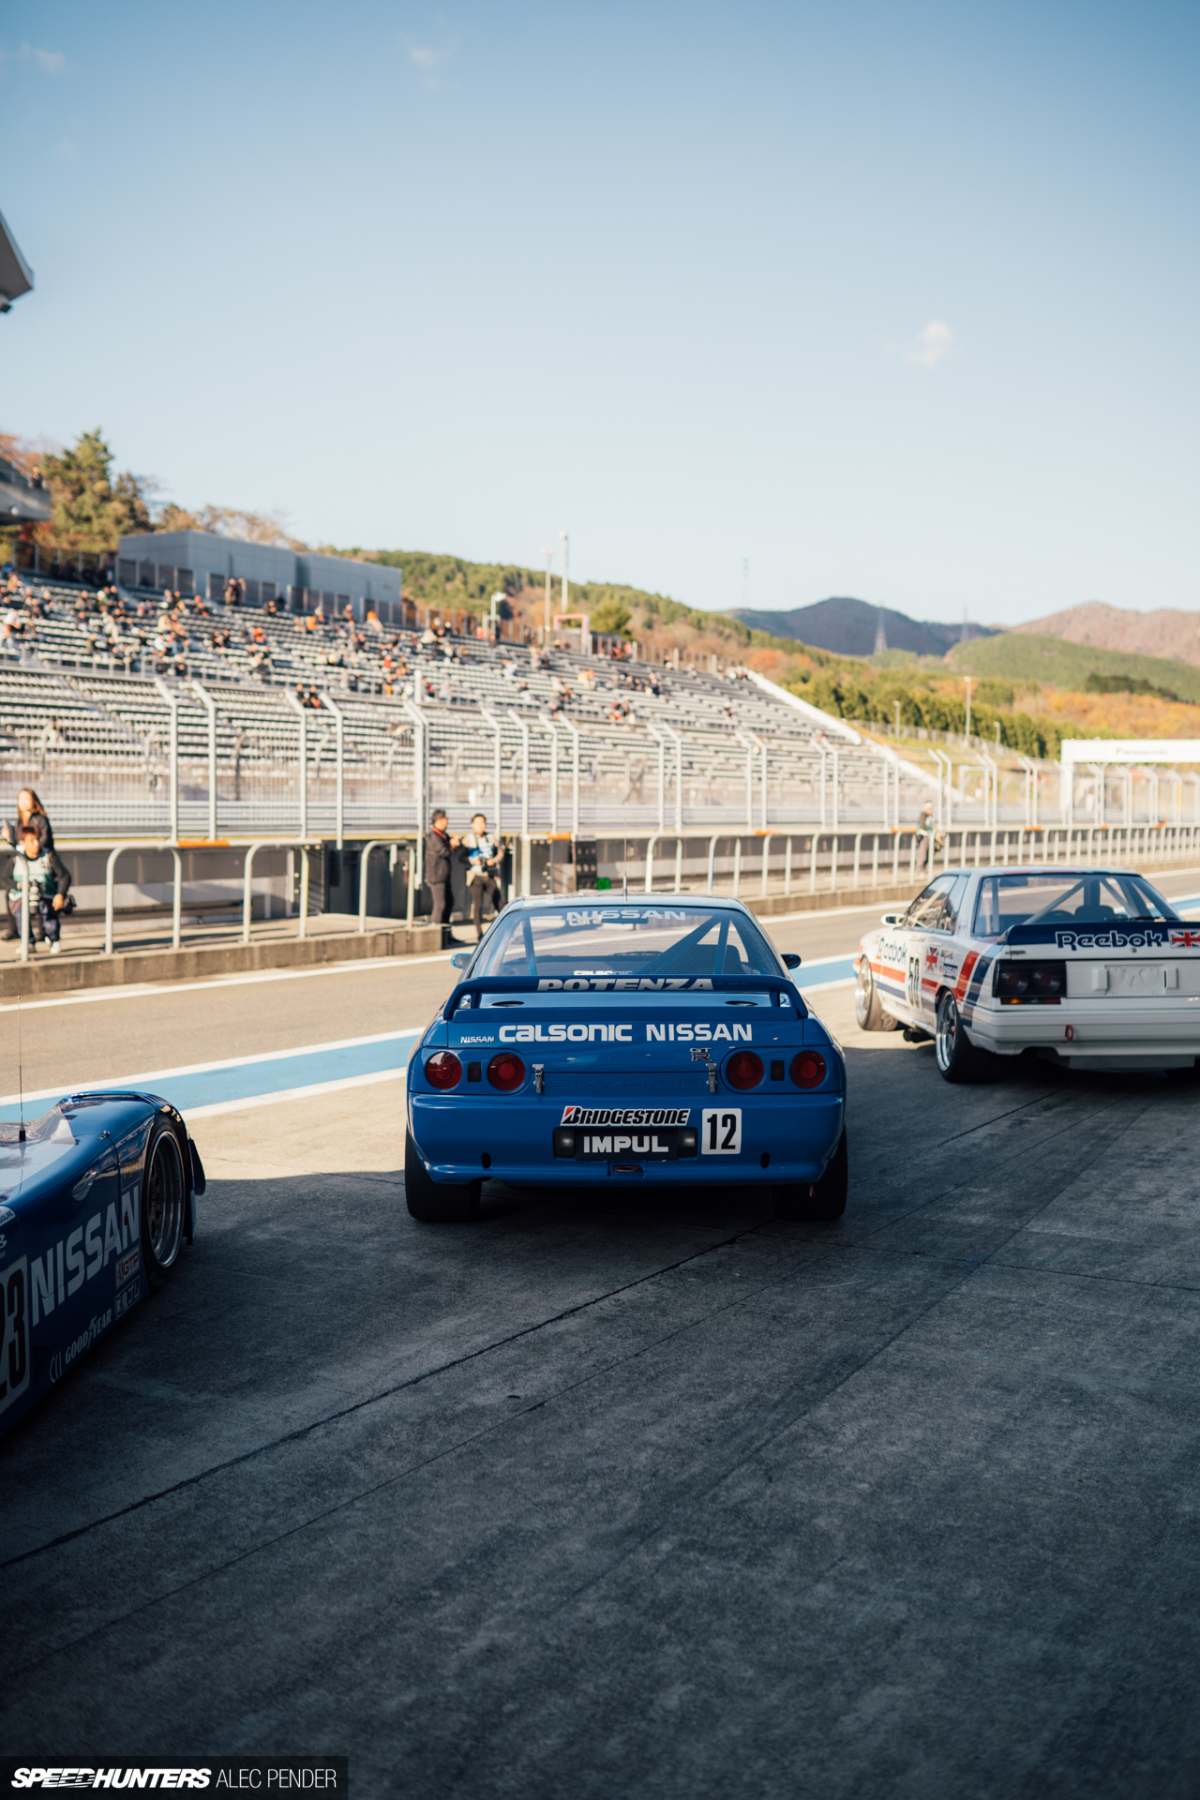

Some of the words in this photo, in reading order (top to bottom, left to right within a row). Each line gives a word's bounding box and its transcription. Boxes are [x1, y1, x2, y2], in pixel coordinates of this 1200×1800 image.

[566, 909, 686, 921] NISSAN
[878, 937, 908, 965] Reebok
[1055, 930, 1162, 951] Reebok
[537, 978, 714, 991] POTENZA
[908, 956, 920, 1008] 50
[460, 1035, 495, 1044] NISSAN
[646, 1023, 753, 1041] NISSAN
[561, 1105, 690, 1126] BRIDGESTONE
[707, 1113, 737, 1150] 12
[583, 1135, 670, 1153] IMPUL
[30, 1185, 140, 1327] NISSAN
[123, 1252, 139, 1276] GTP
[64, 1308, 112, 1365] GOODYEAR
